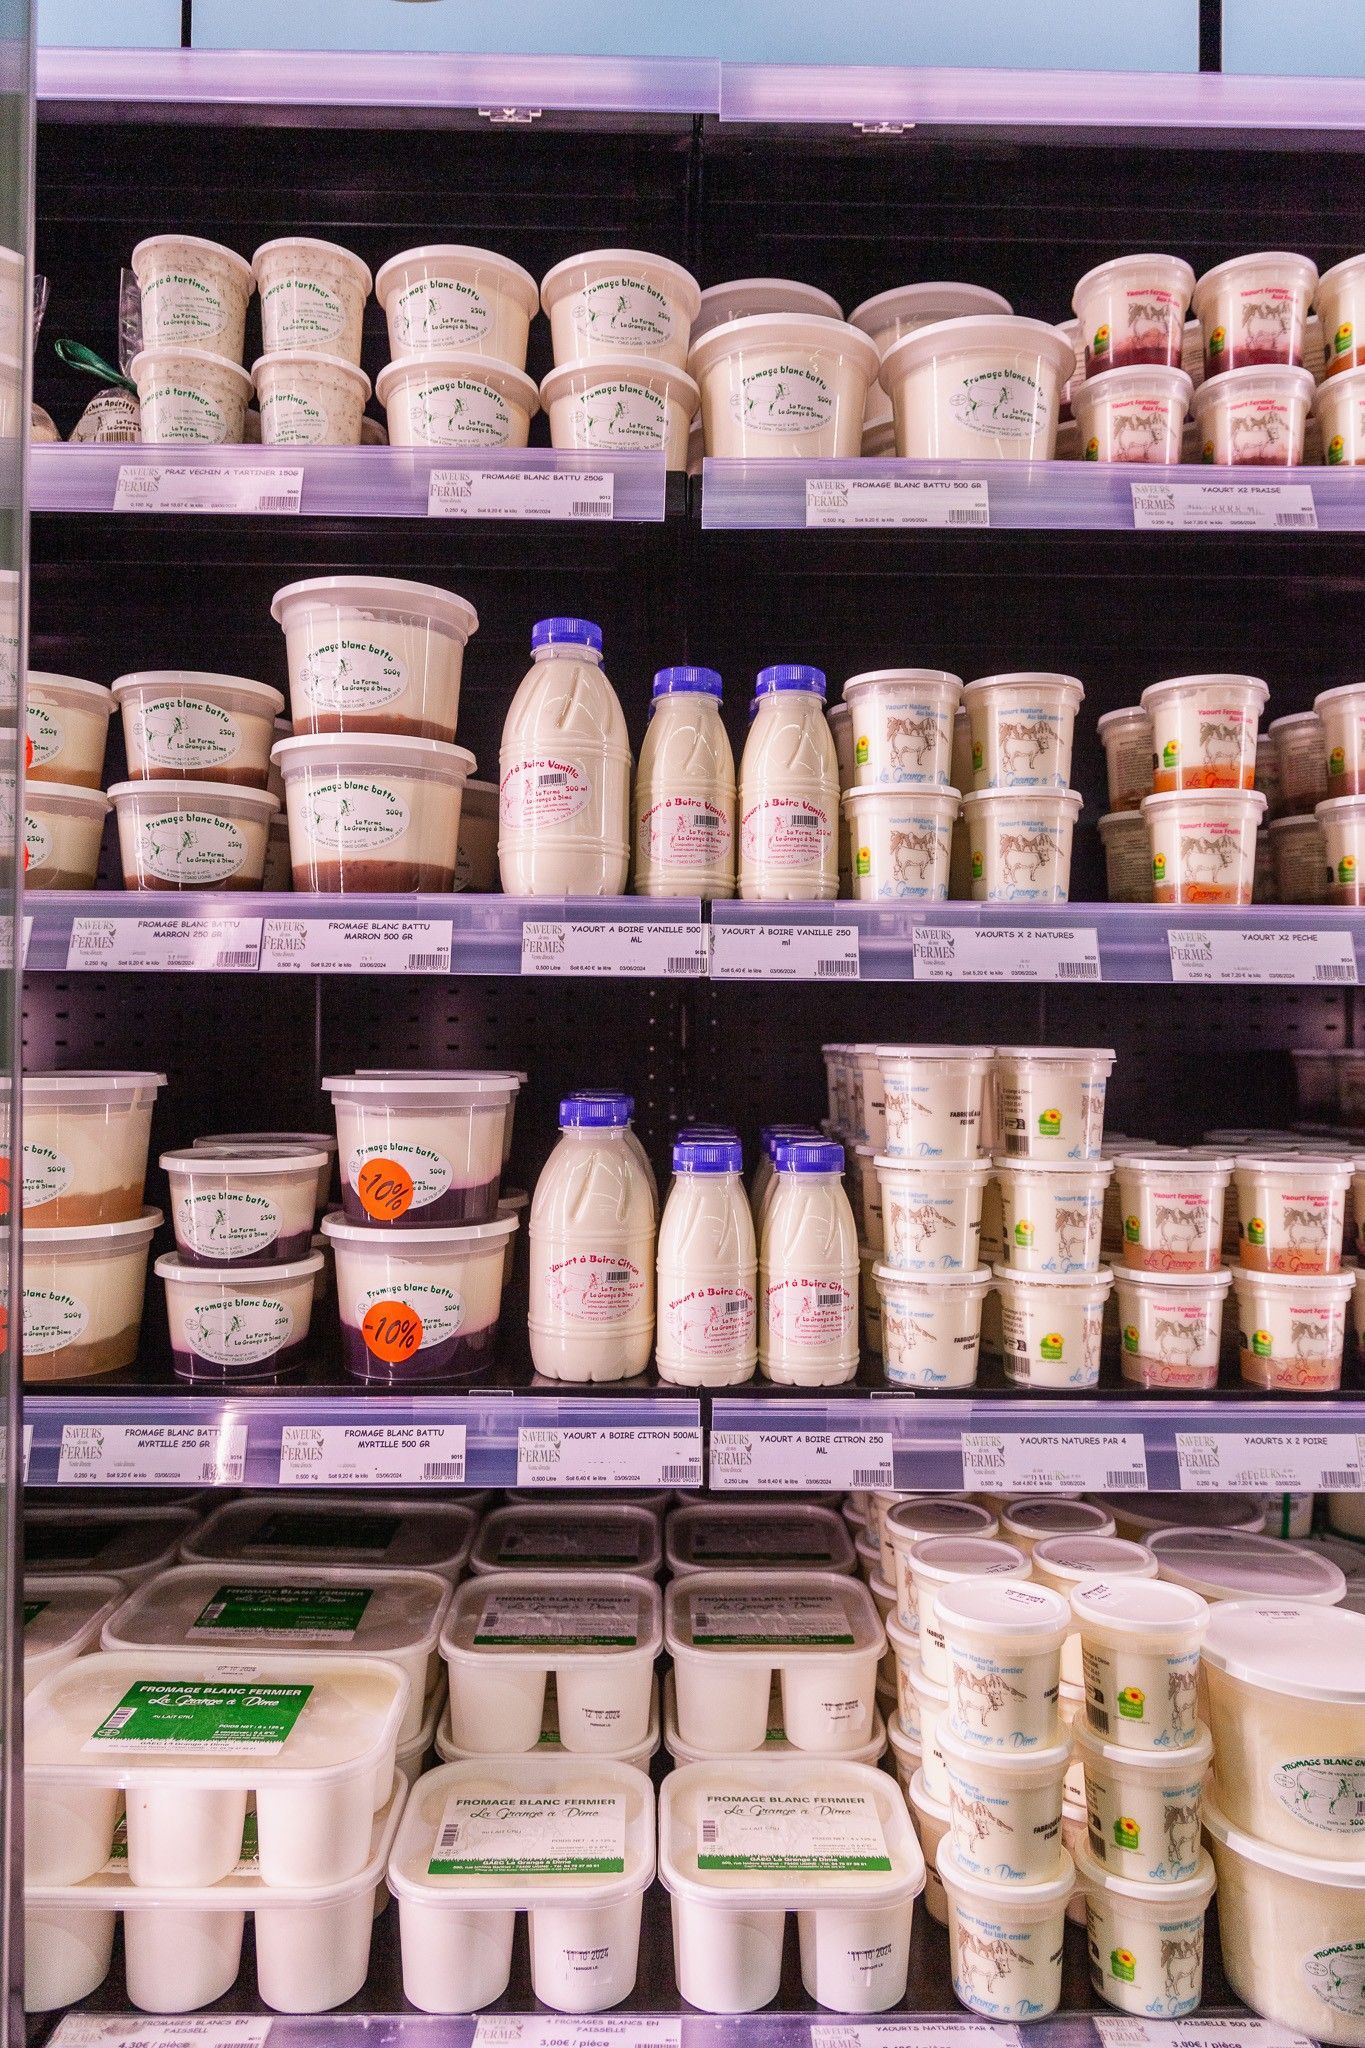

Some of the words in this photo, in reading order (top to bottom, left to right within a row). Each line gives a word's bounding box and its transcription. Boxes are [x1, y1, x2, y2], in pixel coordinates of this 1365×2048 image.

[780, 366, 803, 376] blanc
[805, 371, 827, 390] battu
[457, 381, 482, 393] blanc
[484, 386, 504, 407] battu
[342, 641, 366, 651] blanc
[369, 644, 394, 662] battu
[383, 668, 400, 677] 500g
[548, 760, 579, 778] Vanille
[666, 798, 671, 807] à
[675, 798, 701, 807] Boire
[704, 802, 728, 824] Vanille
[146, 815, 184, 831] Fromage
[186, 814, 212, 825] blanc
[214, 818, 237, 835] battu
[915, 929, 951, 939] SAVEURS
[913, 944, 955, 958] FERMES
[361, 1173, 409, 1211] -10%
[218, 1193, 243, 1202] blanc
[245, 1195, 270, 1208] battu
[589, 1255, 615, 1264] Boire
[618, 1258, 639, 1275] Citron
[195, 1302, 232, 1314] Fromage
[234, 1300, 260, 1308] blanc
[263, 1300, 284, 1312] battu
[365, 1318, 417, 1349] -10%
[345, 1429, 384, 1437] FROMAGE
[138, 1440, 179, 1448] MYRTILLE
[140, 1686, 200, 1694] FROMAGE
[204, 1687, 246, 1695] BLANC
[148, 1695, 171, 1705] La
[176, 1695, 222, 1707] Grange
[1282, 1759, 1321, 1772] FROMAGE
[470, 1808, 491, 1818] La
[496, 1808, 543, 1819] Grange
[724, 1805, 744, 1815] La
[750, 1805, 796, 1817] Grange
[1314, 1944, 1353, 1960] FROMAGE
